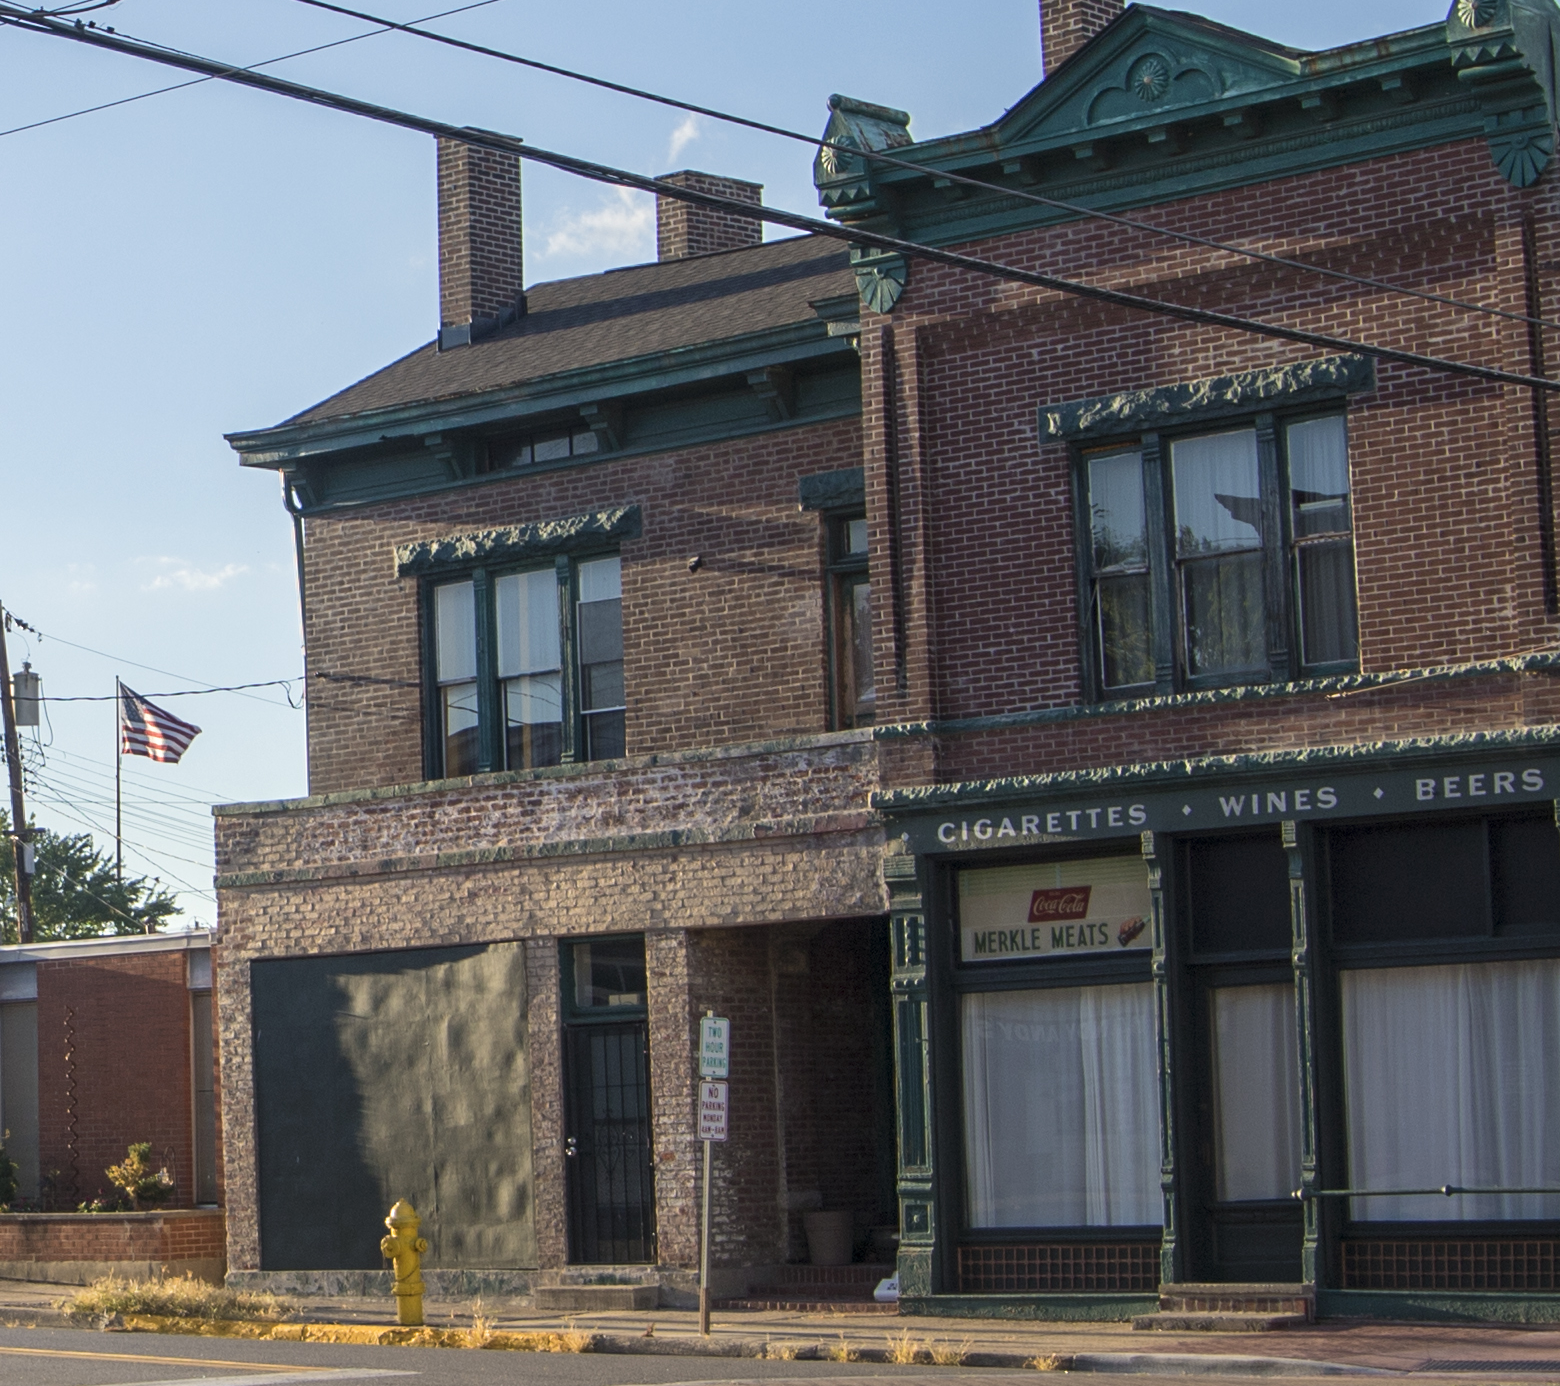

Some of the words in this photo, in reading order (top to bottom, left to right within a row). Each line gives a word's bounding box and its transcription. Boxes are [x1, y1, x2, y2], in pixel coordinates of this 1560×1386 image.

[937, 804, 1147, 844] CIGARETTES
[1219, 787, 1338, 818] WINES
[1415, 769, 1545, 801] BEERS
[974, 928, 1041, 954] MERKLE
[1051, 923, 1109, 949] MEATS
[708, 1026, 722, 1038] TWO
[705, 1042, 723, 1053] HOUR
[703, 1057, 726, 1068] PARKING
[708, 1087, 719, 1098] NO
[702, 1101, 724, 1111] PARKING
